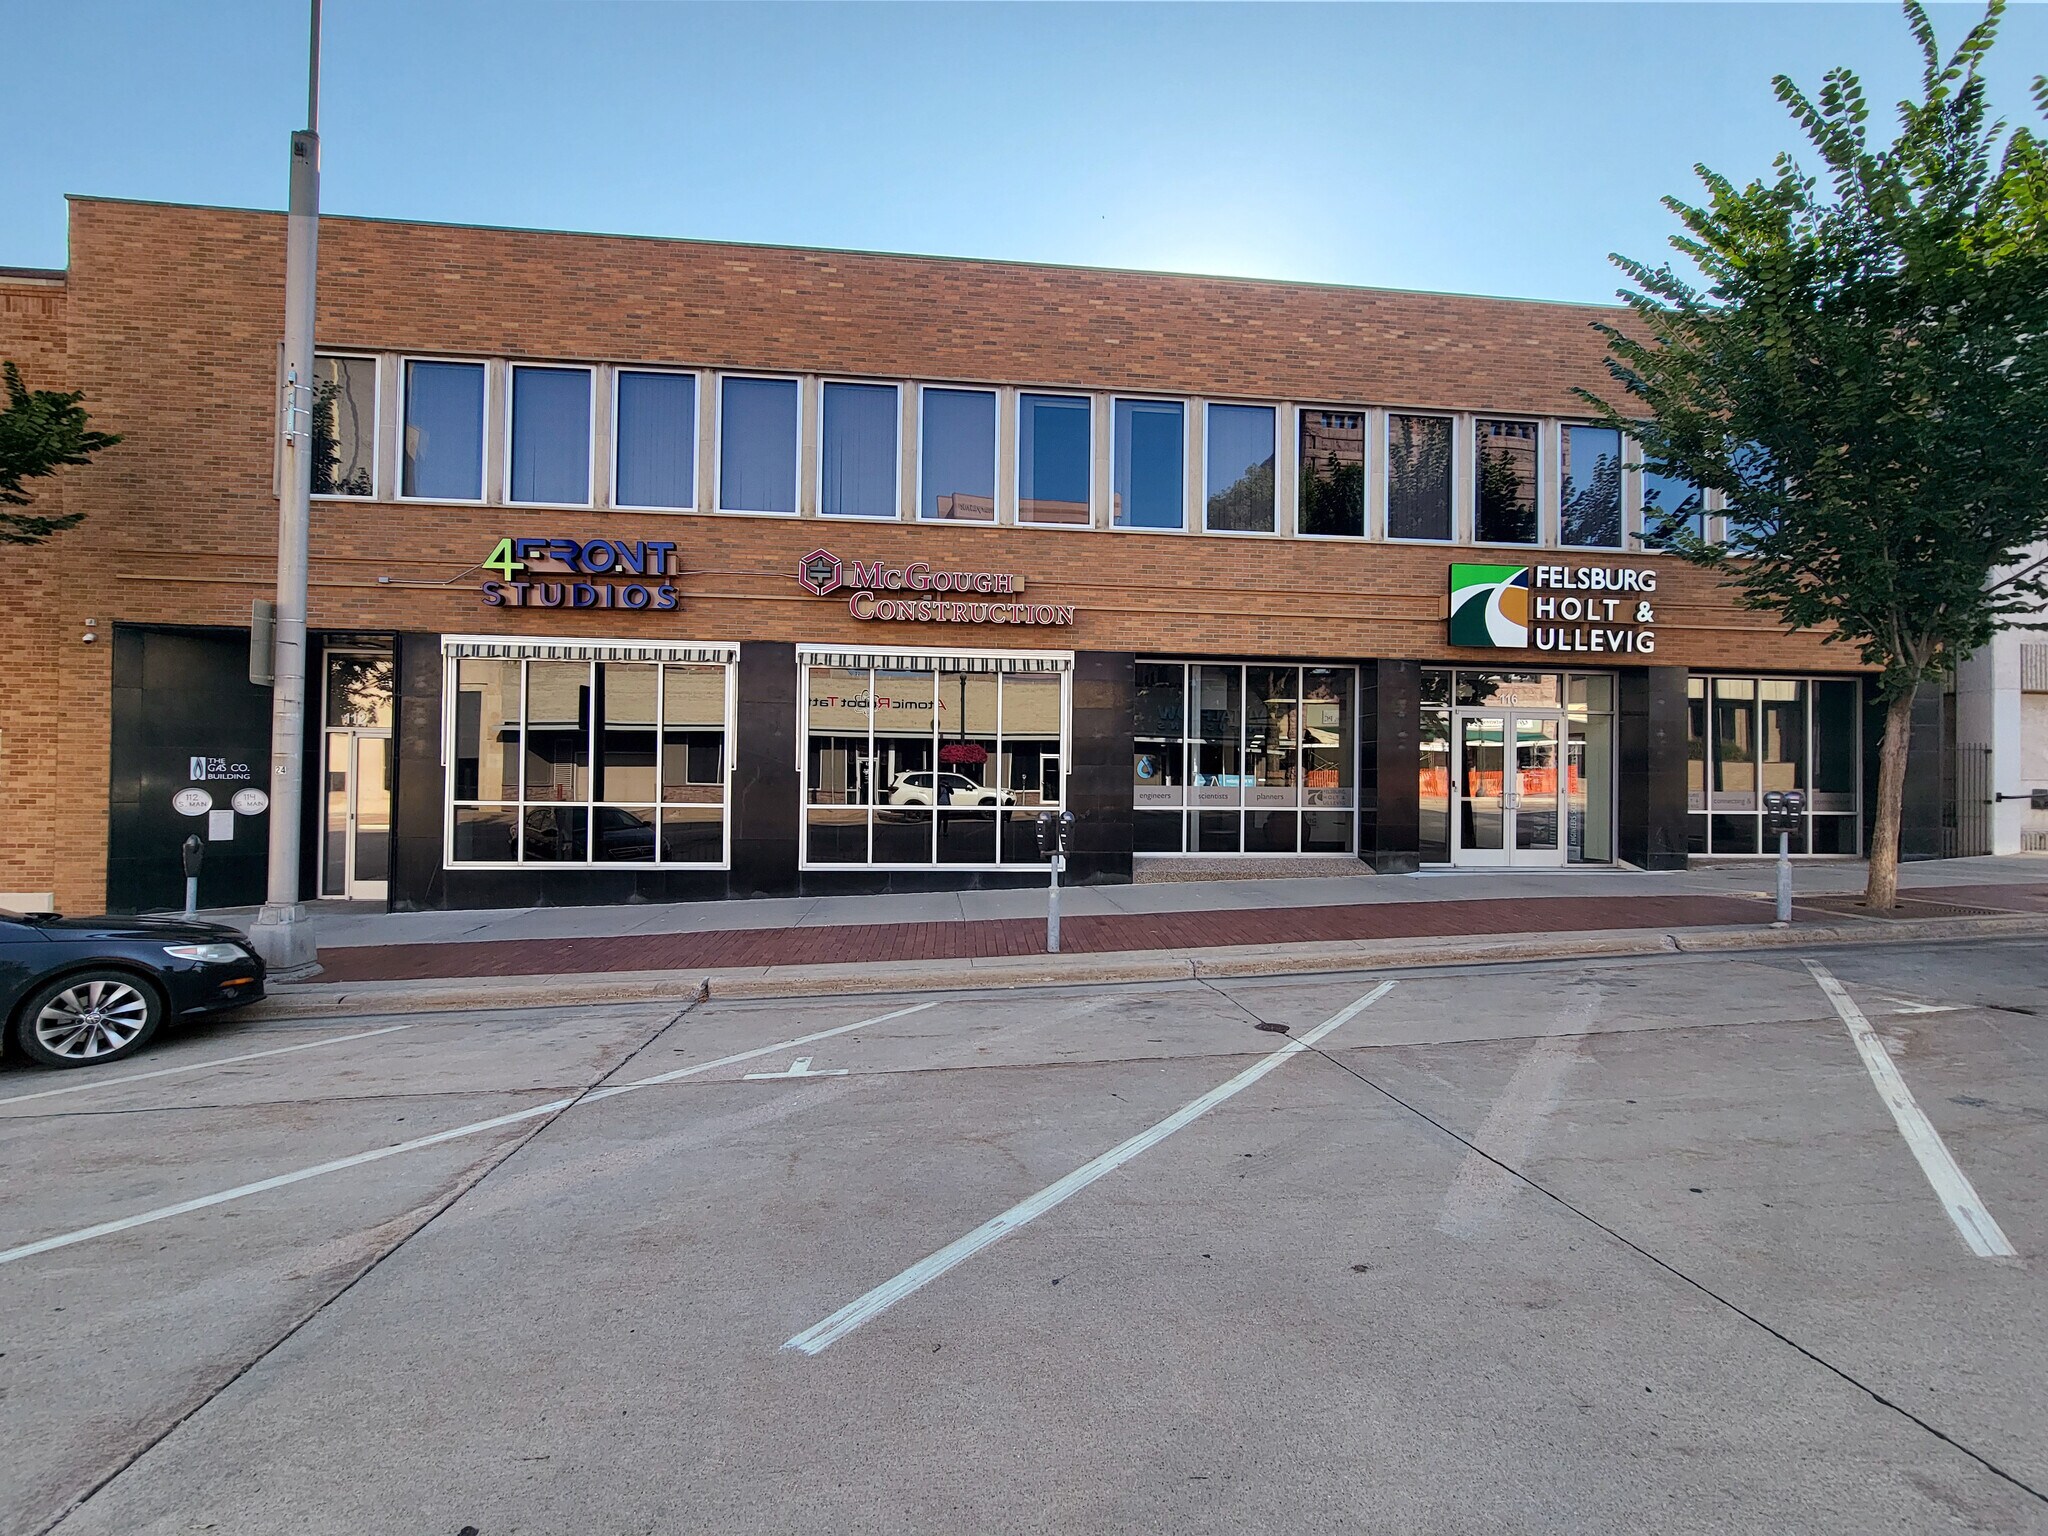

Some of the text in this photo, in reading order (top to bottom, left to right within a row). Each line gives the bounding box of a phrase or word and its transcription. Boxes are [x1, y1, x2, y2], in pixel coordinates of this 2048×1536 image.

[1535, 565, 1657, 592] FELSBURG
[481, 580, 678, 610] STUDIOS
[1535, 596, 1655, 623] HOLT &
[1535, 627, 1656, 653] ULLEVIG
[1498, 693, 1518, 705] 116
[207, 763, 251, 772] GAS CO.
[185, 793, 199, 801] 112
[1139, 792, 1172, 801] engineers
[1198, 792, 1229, 800] scientists
[1256, 793, 1285, 802] planners
